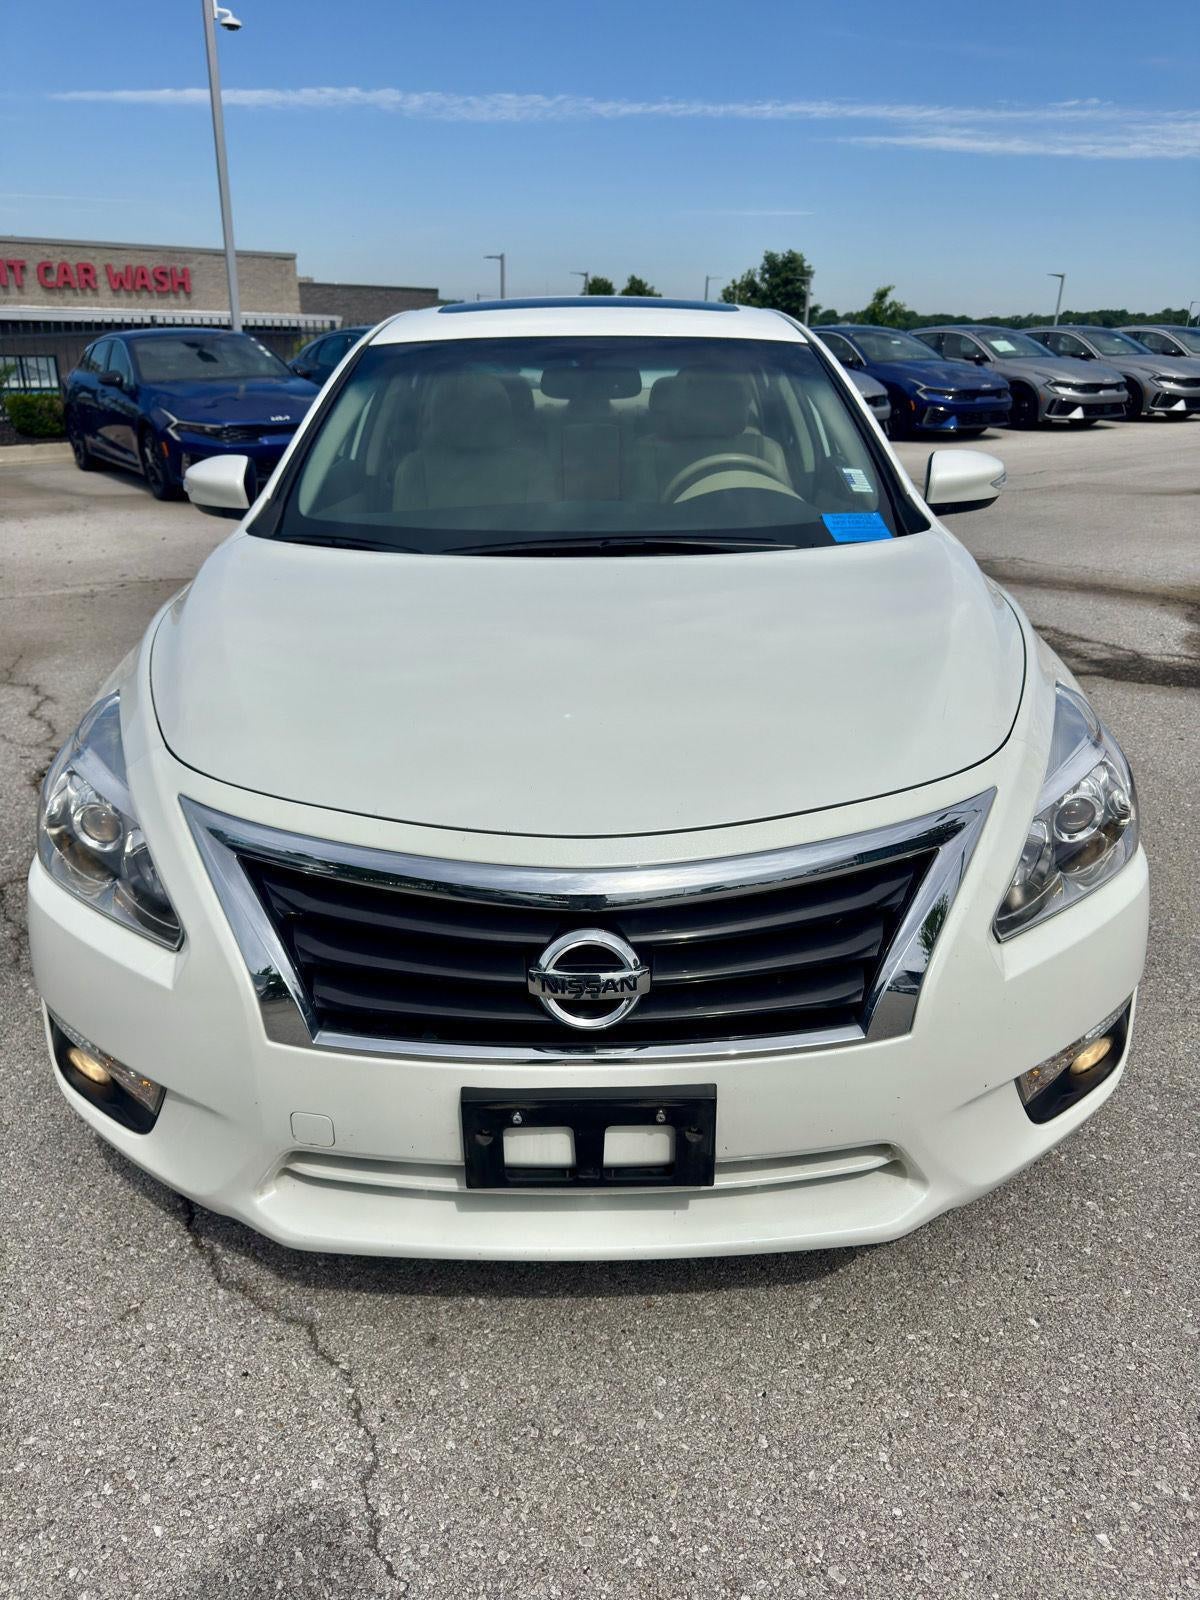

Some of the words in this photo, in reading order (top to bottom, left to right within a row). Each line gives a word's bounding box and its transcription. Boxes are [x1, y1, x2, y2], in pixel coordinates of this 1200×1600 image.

[37, 260, 99, 289] CAR
[105, 264, 192, 293] WASH
[541, 978, 637, 994] NISSAN
